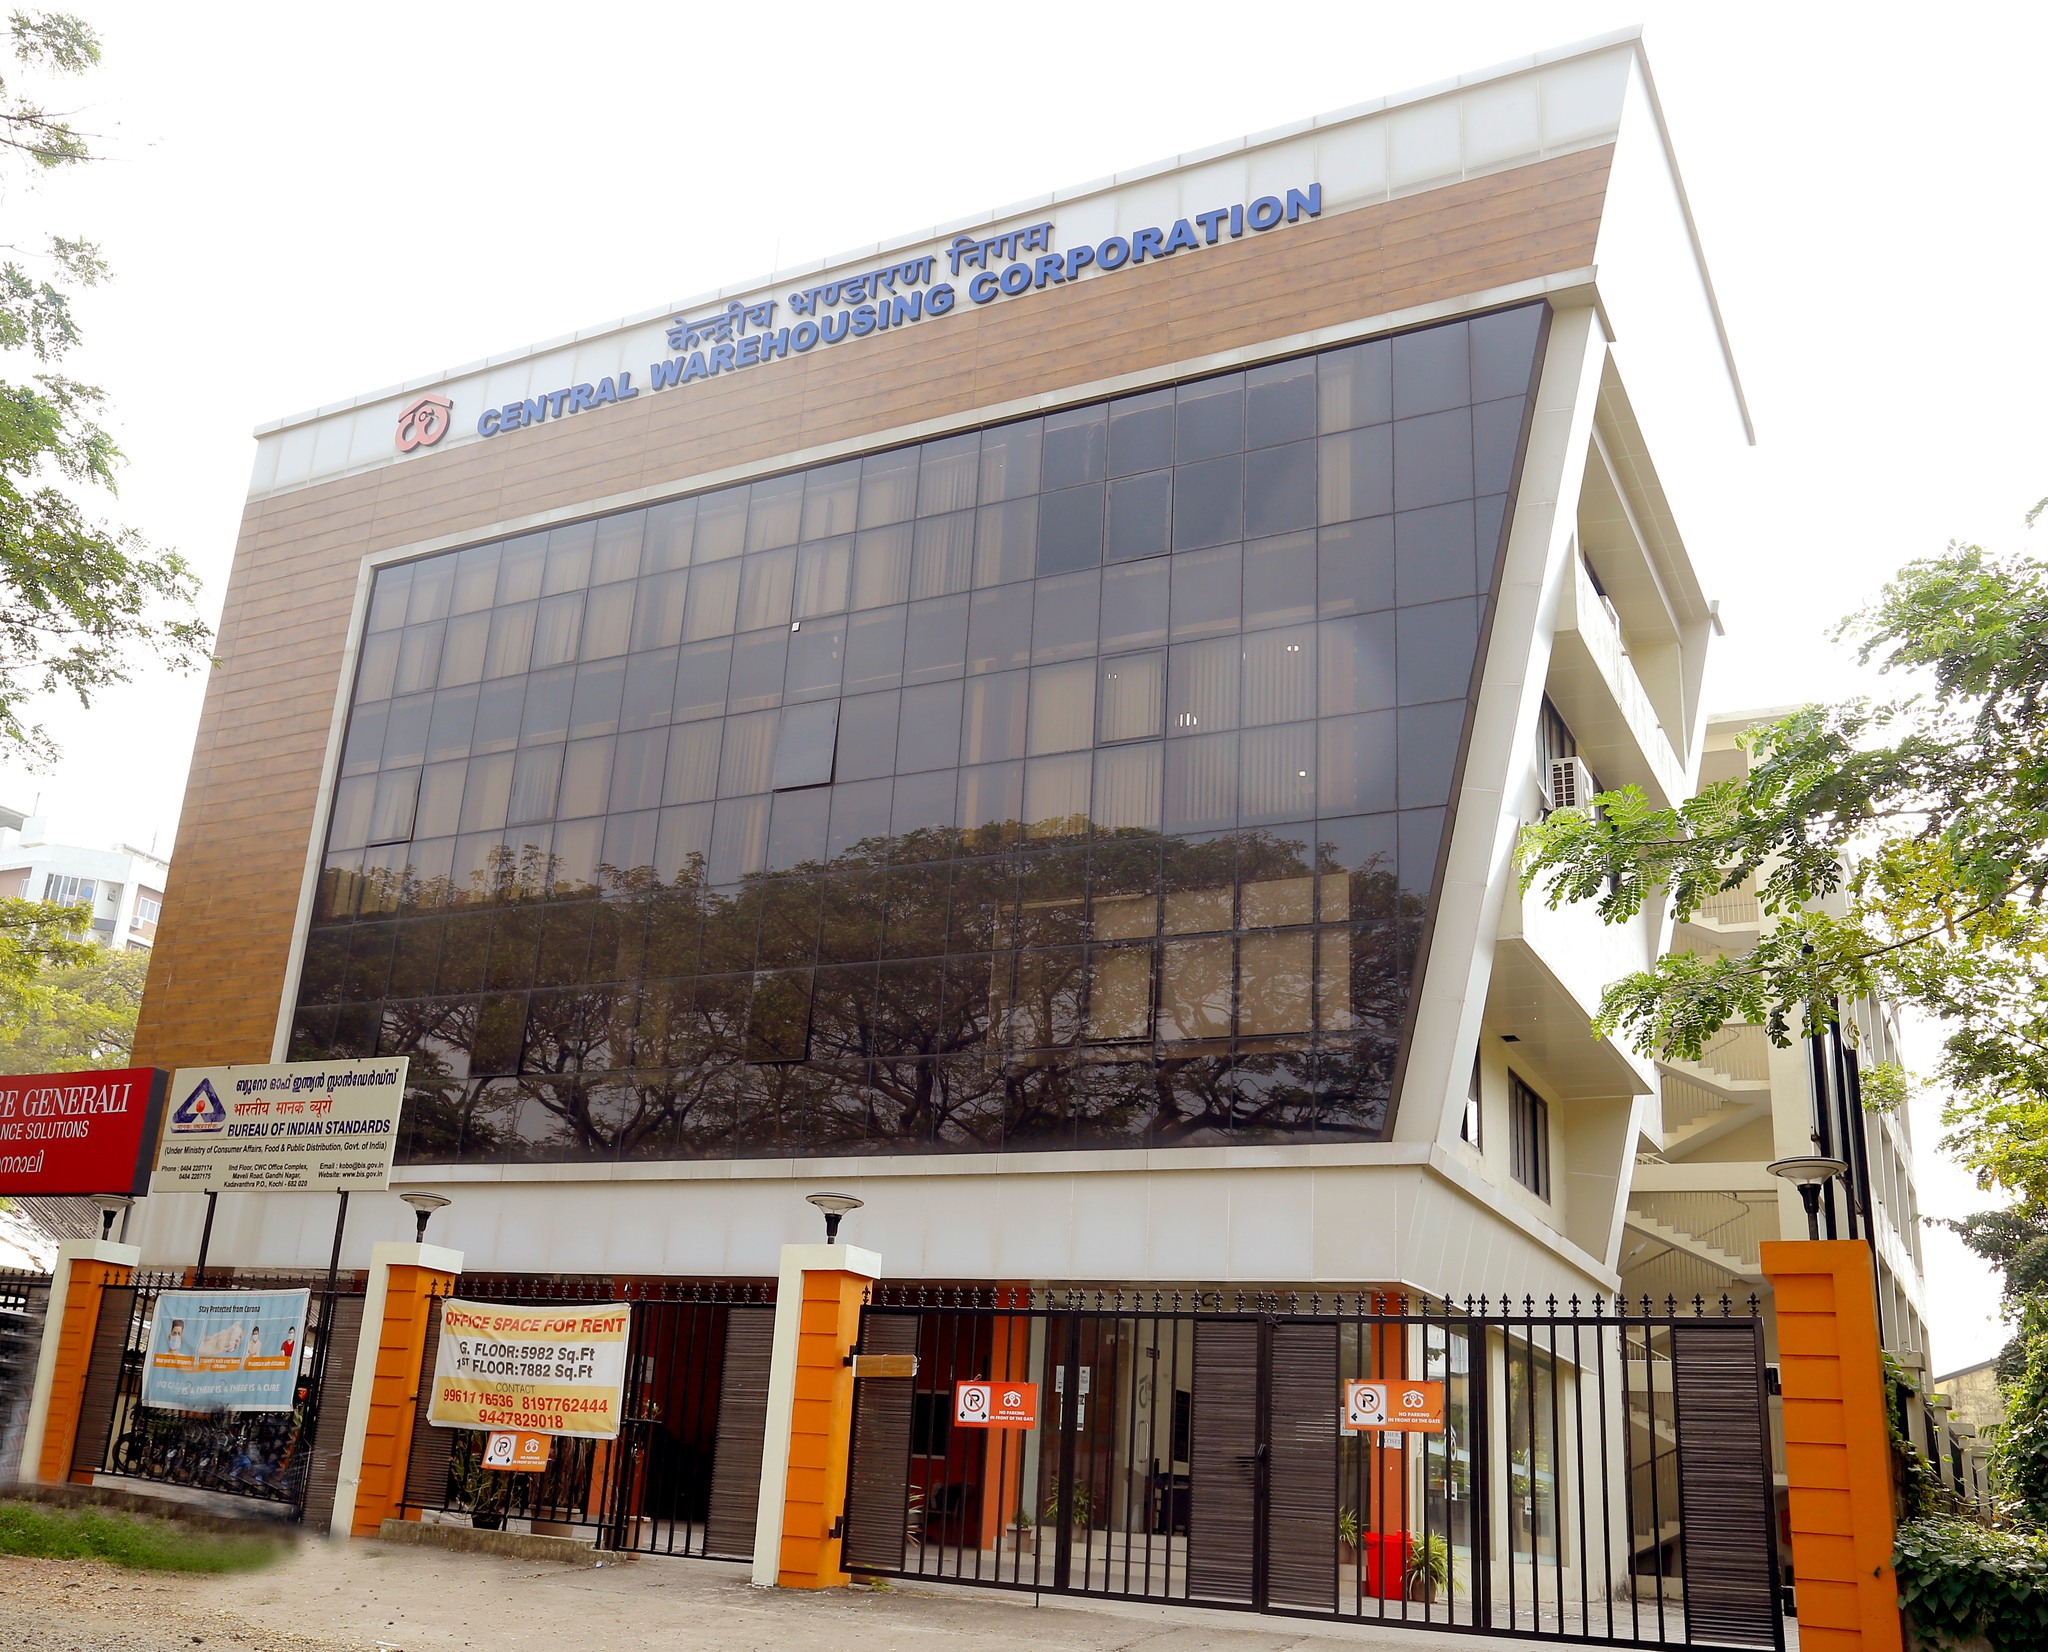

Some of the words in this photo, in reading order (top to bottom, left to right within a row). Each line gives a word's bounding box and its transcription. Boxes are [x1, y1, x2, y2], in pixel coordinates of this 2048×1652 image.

[666, 300, 778, 351] केन्द्रीय
[788, 255, 937, 316] भण्डारण
[945, 221, 1055, 277] निगम
[477, 371, 639, 437] CENTRAL
[650, 282, 955, 392] WAREHOUSING
[969, 182, 1322, 305] CORPORATION
[23, 1083, 132, 1117] GENERALI
[234, 1098, 270, 1116] भारतीय
[276, 1101, 305, 1115] मानक
[25, 1120, 89, 1140] SOLUTIONS
[228, 1123, 268, 1137] BUREAU
[271, 1122, 285, 1136] OF
[287, 1121, 322, 1135] INDIAN
[325, 1119, 390, 1134] STANDARDS
[164, 1146, 183, 1156] (Under
[184, 1145, 205, 1155] Ministry
[206, 1145, 213, 1153] of
[213, 1145, 242, 1154] Consumer
[243, 1144, 263, 1154] Affairs,
[264, 1144, 279, 1152] Food
[280, 1144, 286, 1152] &
[286, 1143, 305, 1152] Public
[306, 1142, 342, 1152] Distribution,
[344, 1142, 360, 1151] Govt.
[361, 1141, 369, 1150] of
[369, 1141, 387, 1151] India)
[284, 1163, 308, 1171] Complex,
[342, 1170, 382, 1178] www.bis.gov.in
[198, 1305, 209, 1314] Stay
[210, 1305, 232, 1313] Protected
[232, 1305, 243, 1313] from
[244, 1305, 260, 1313] Corona
[445, 1312, 491, 1329] OFFICE
[493, 1317, 541, 1332] SPACE
[543, 1319, 577, 1332] FOR
[580, 1317, 626, 1333] RENT
[459, 1341, 470, 1355] G.
[557, 1347, 595, 1364] Sq.Ft
[554, 1364, 593, 1381] Sq.Ft
[263, 1383, 280, 1392] CURE
[496, 1382, 535, 1394] CONTACT
[522, 1396, 608, 1413] 8197762444
[479, 1409, 563, 1428] 9447829018
